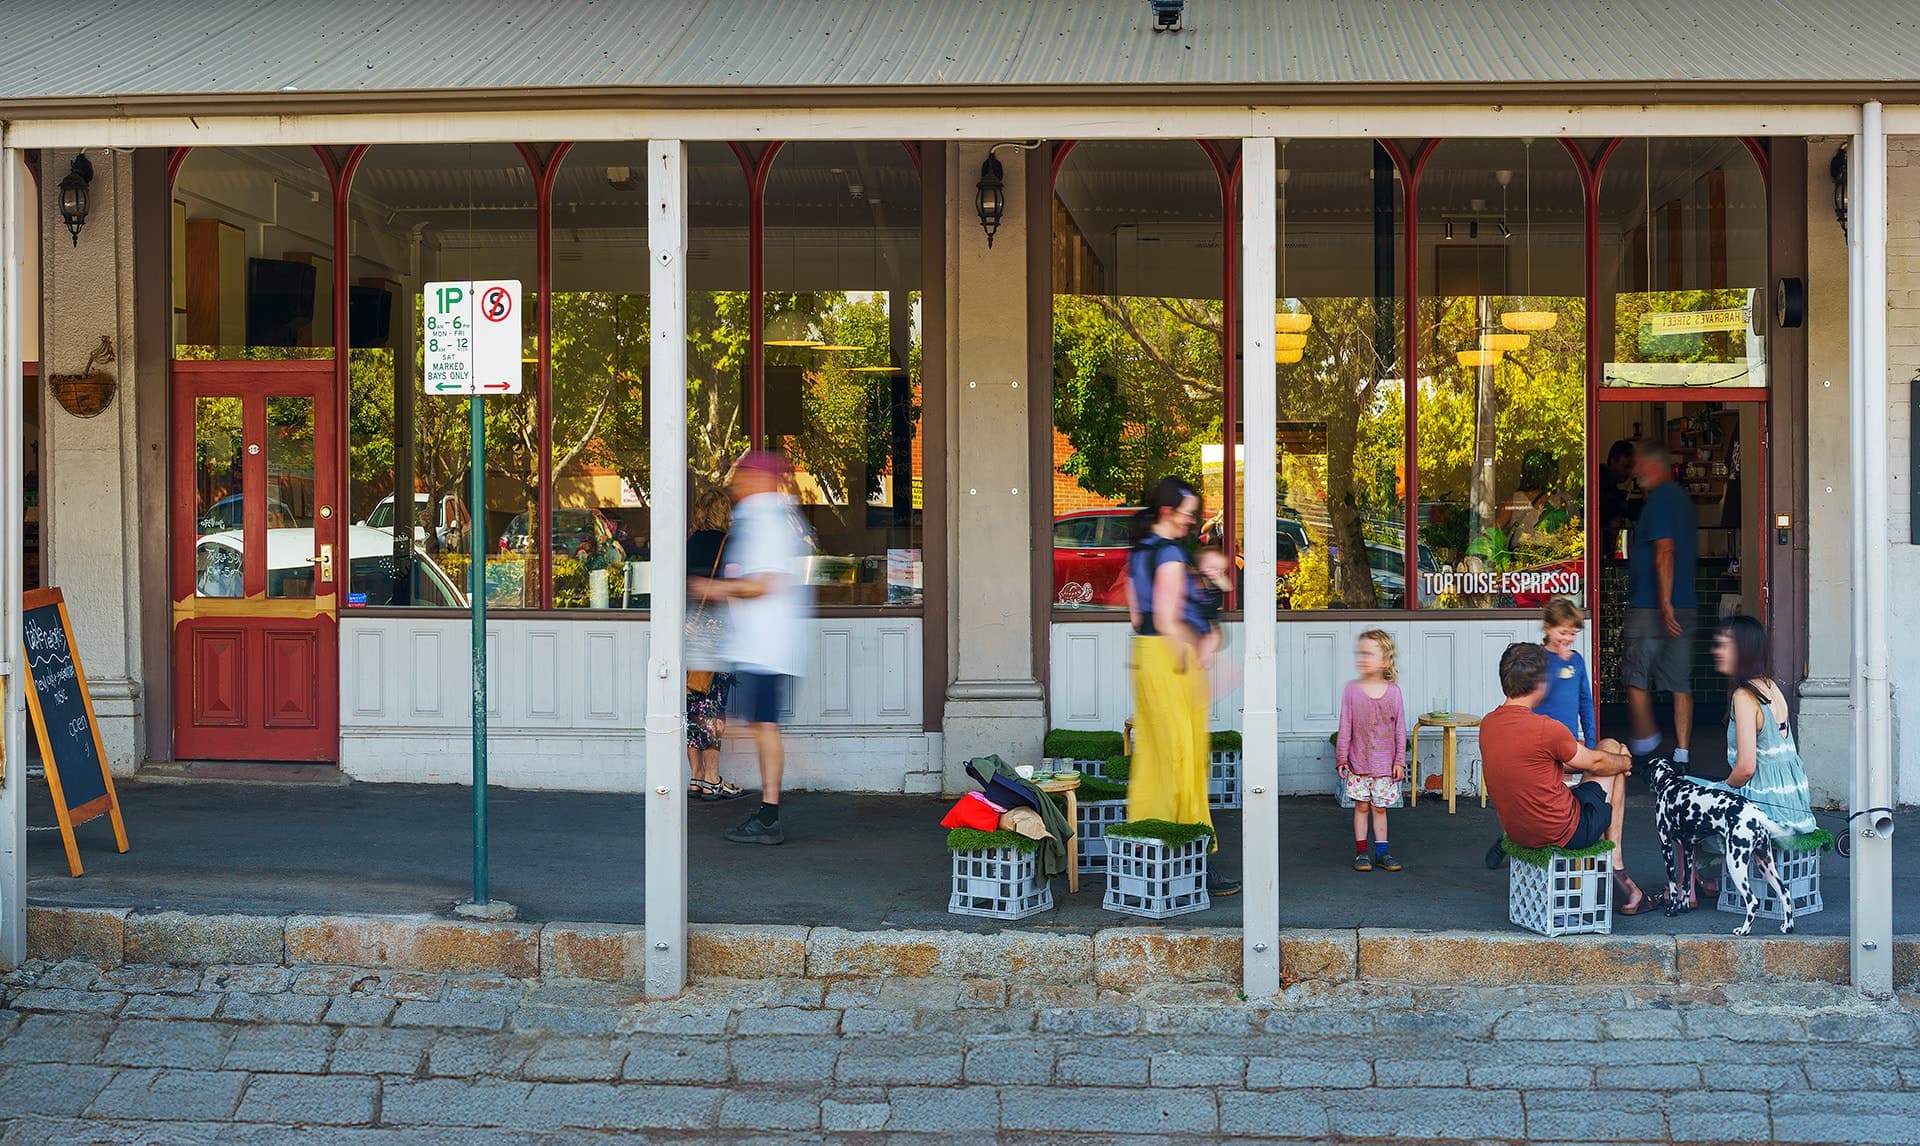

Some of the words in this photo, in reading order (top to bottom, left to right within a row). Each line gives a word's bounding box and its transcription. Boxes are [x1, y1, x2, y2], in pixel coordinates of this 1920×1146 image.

[436, 287, 463, 314] 1P
[457, 337, 469, 348] 12
[442, 353, 455, 361] SAT
[432, 362, 465, 371] MARKED
[427, 371, 447, 380] BAYS
[449, 371, 470, 380] ONLY
[1423, 572, 1499, 595] TORTOISE
[1501, 572, 1580, 595] ESPRESSO
[68, 714, 88, 743] open
